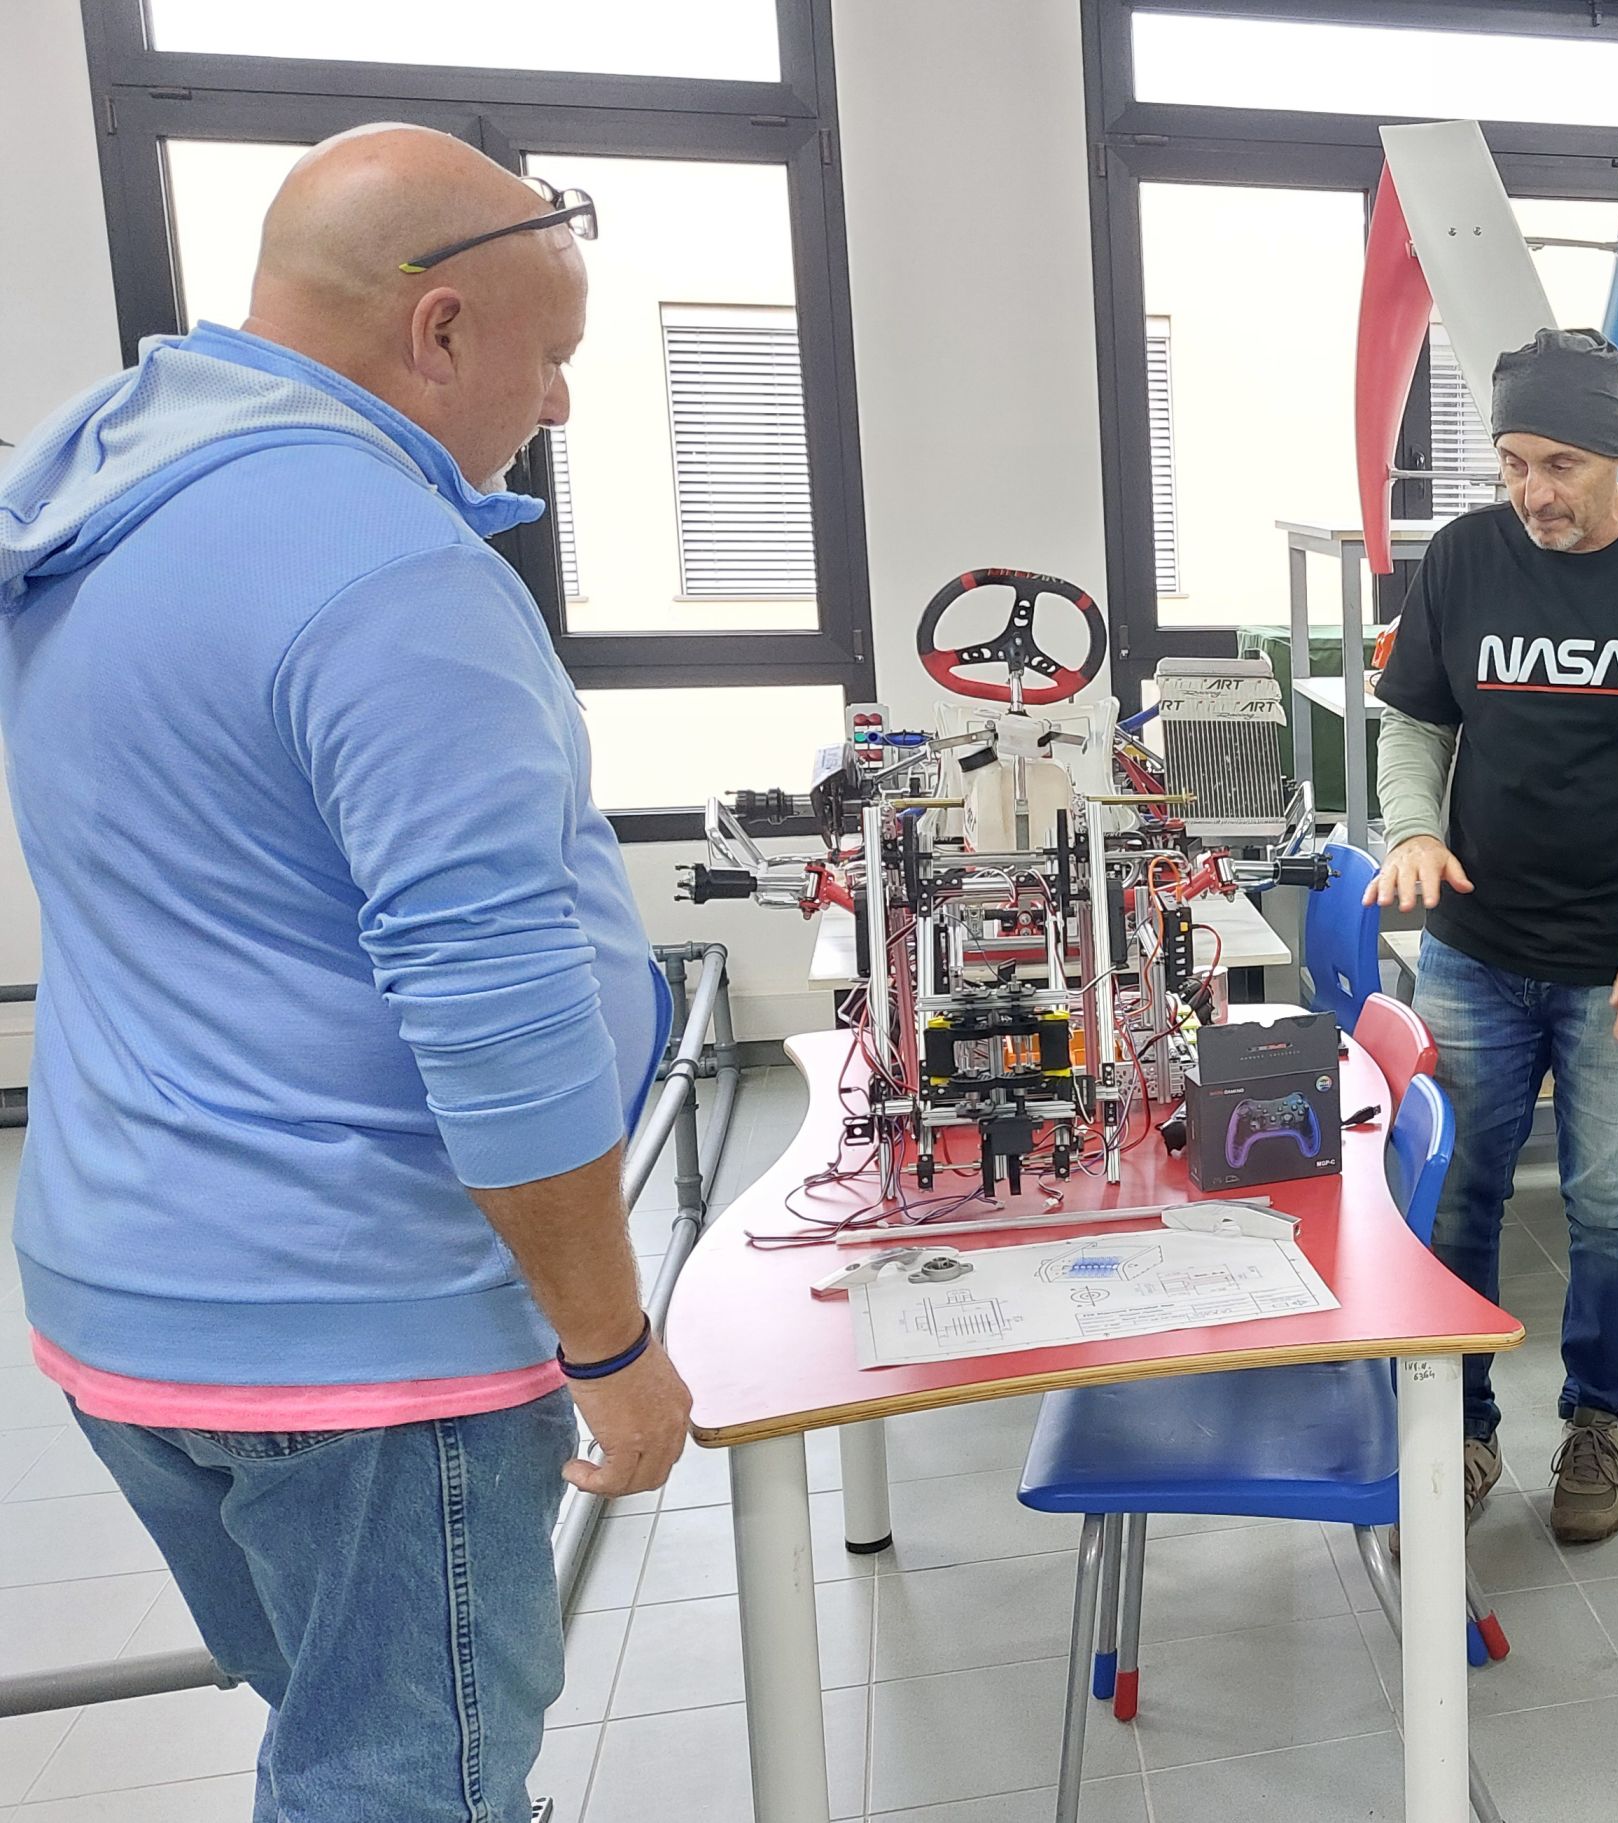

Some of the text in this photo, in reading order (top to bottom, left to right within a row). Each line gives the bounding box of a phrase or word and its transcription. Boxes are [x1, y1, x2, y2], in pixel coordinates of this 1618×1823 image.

[1206, 679, 1245, 690] ART
[1160, 699, 1184, 711] RT
[1240, 701, 1275, 713] ART
